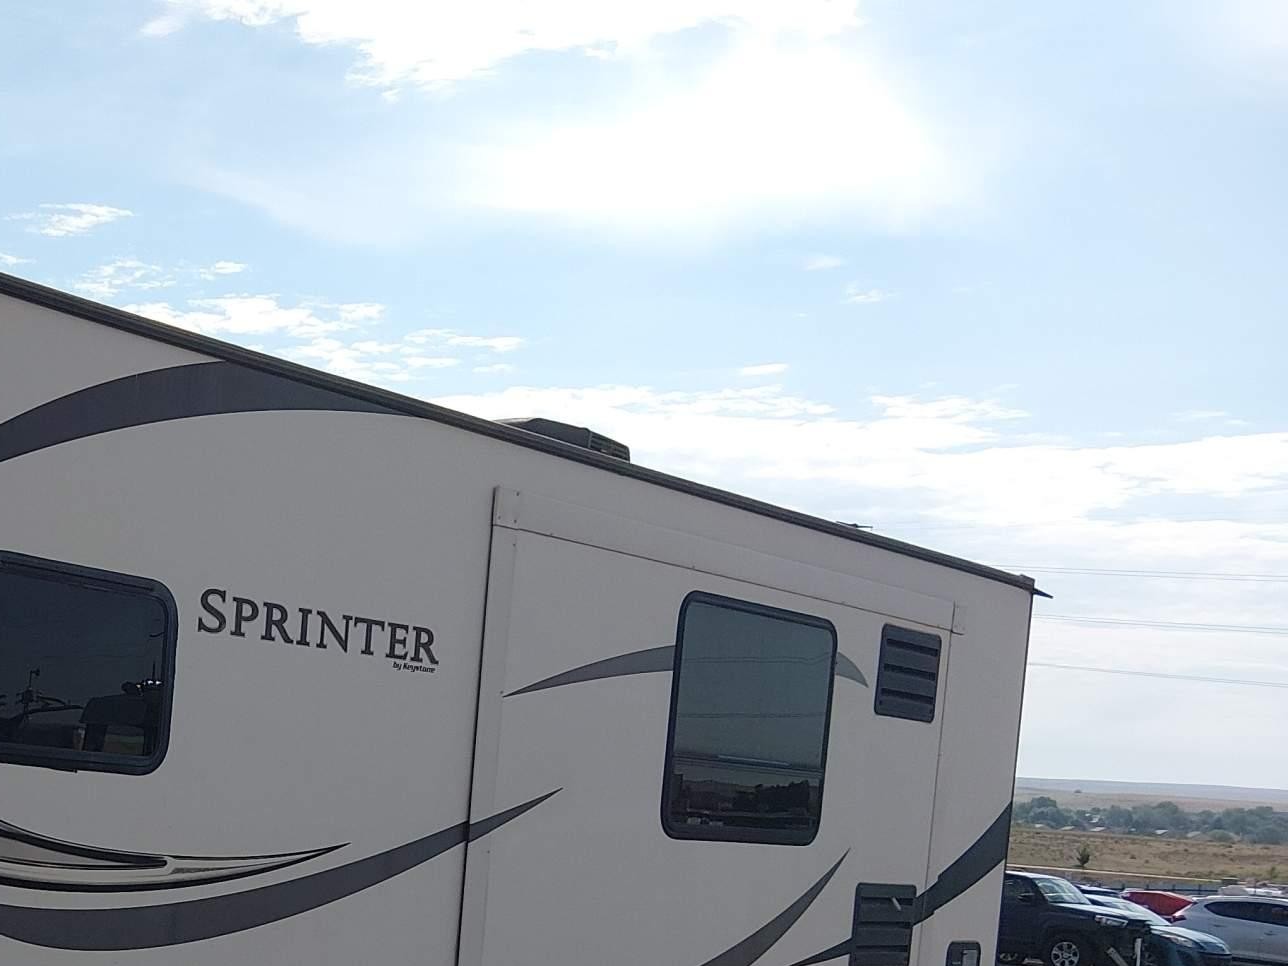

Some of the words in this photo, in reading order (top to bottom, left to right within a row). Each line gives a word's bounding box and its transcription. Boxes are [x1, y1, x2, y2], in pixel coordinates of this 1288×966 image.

[197, 588, 439, 665] SPRINTER
[392, 661, 403, 671] by
[402, 662, 436, 674] Keystone
